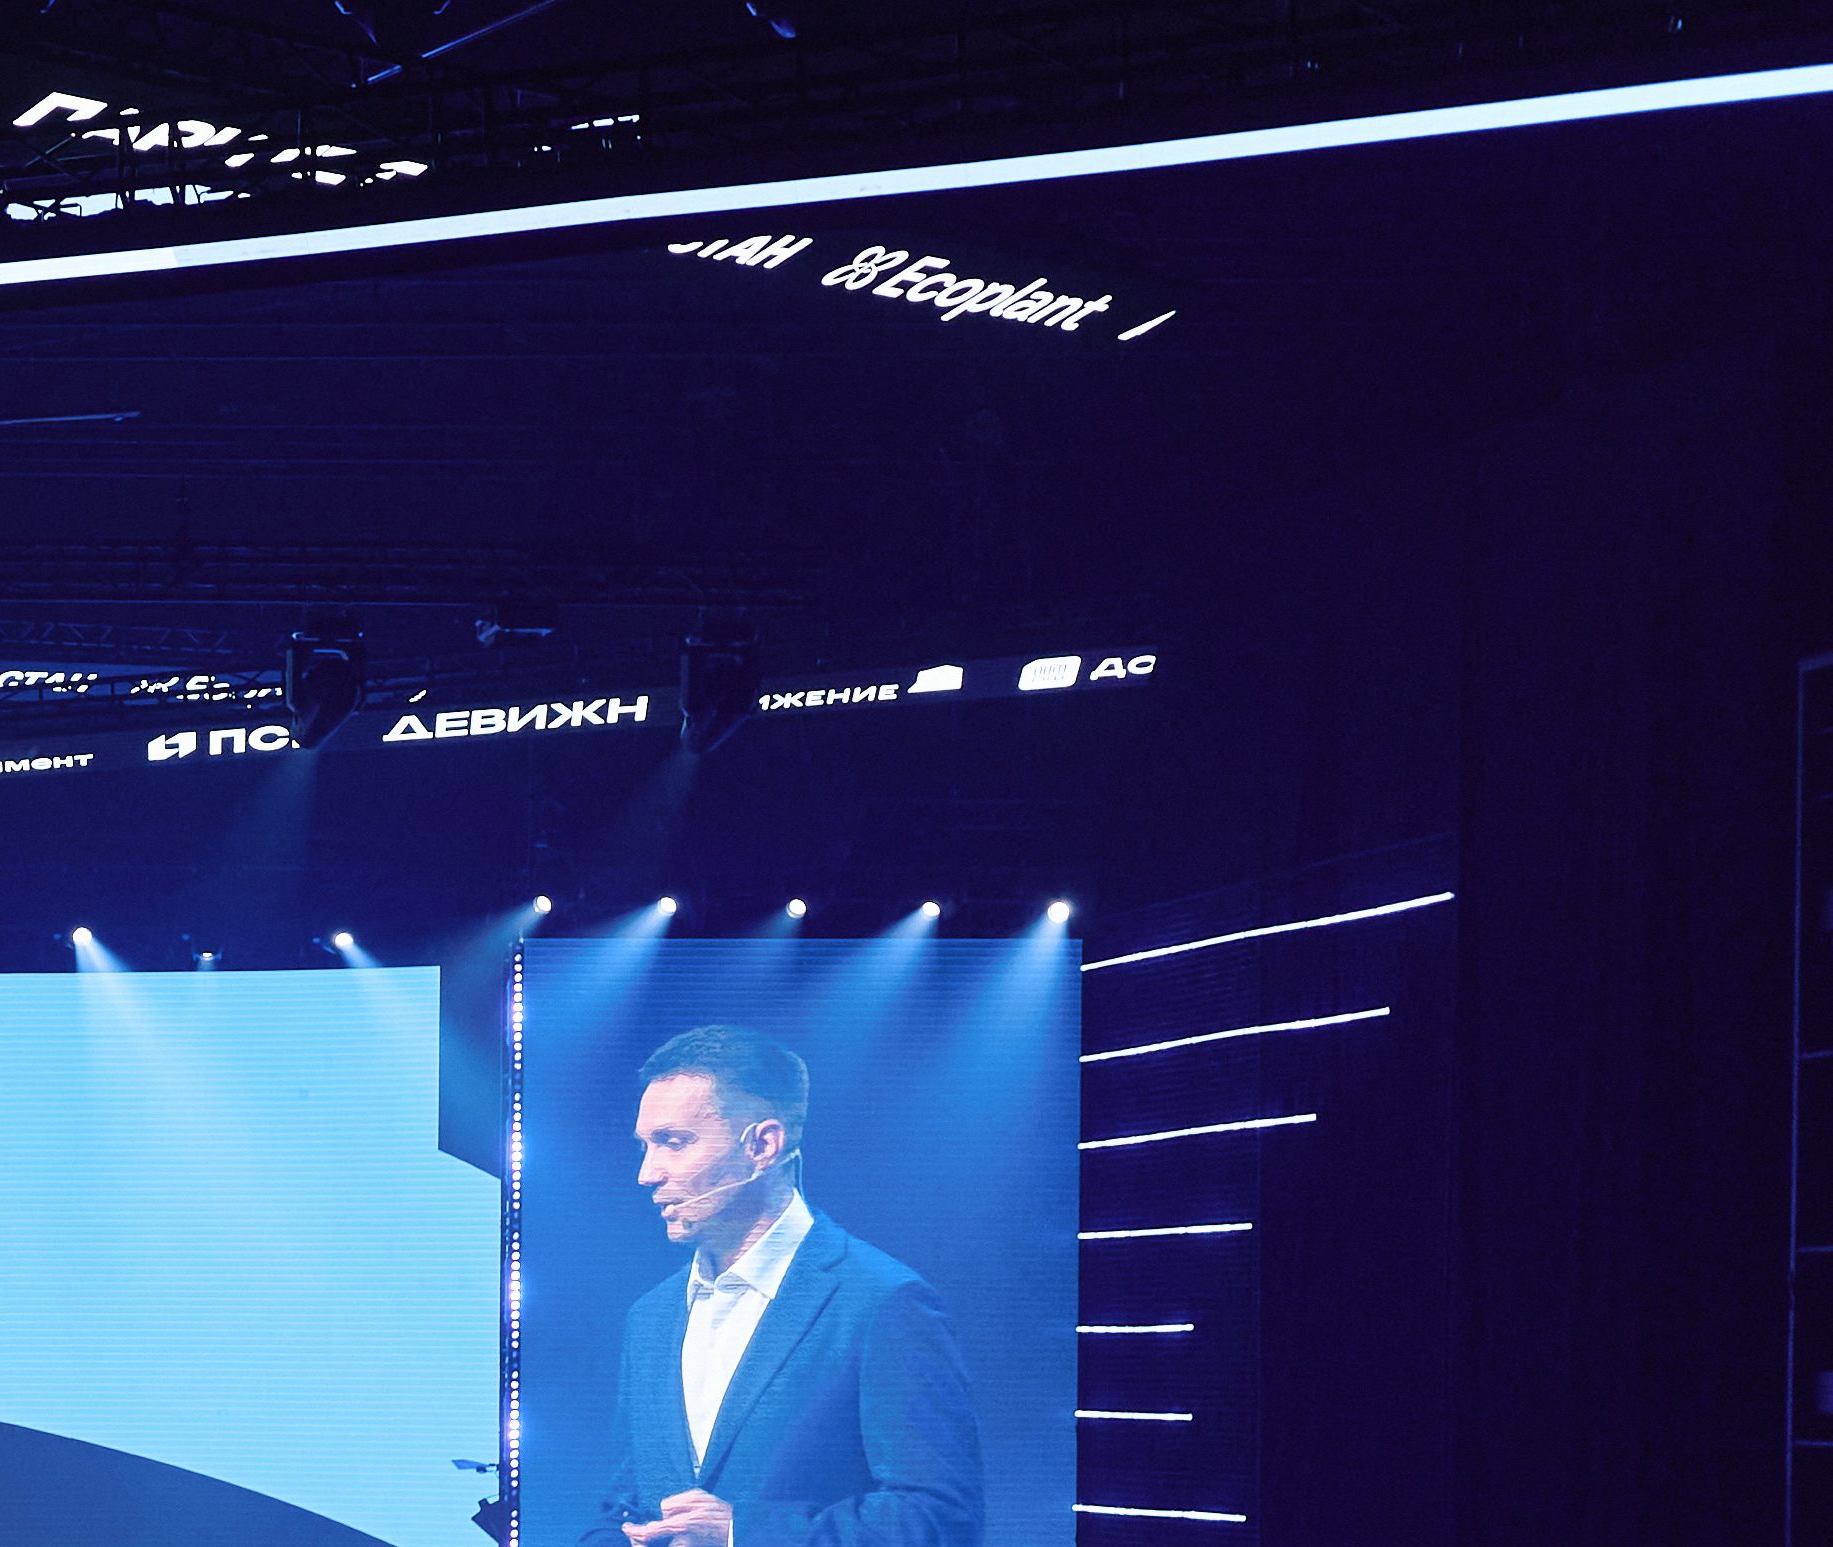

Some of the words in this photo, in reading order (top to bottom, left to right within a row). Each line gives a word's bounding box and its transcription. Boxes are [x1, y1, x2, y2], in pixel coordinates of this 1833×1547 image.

[871, 255, 1113, 331] Ecoplant
[209, 725, 300, 756] ПС
[382, 695, 649, 742] ДЕВИЖН
